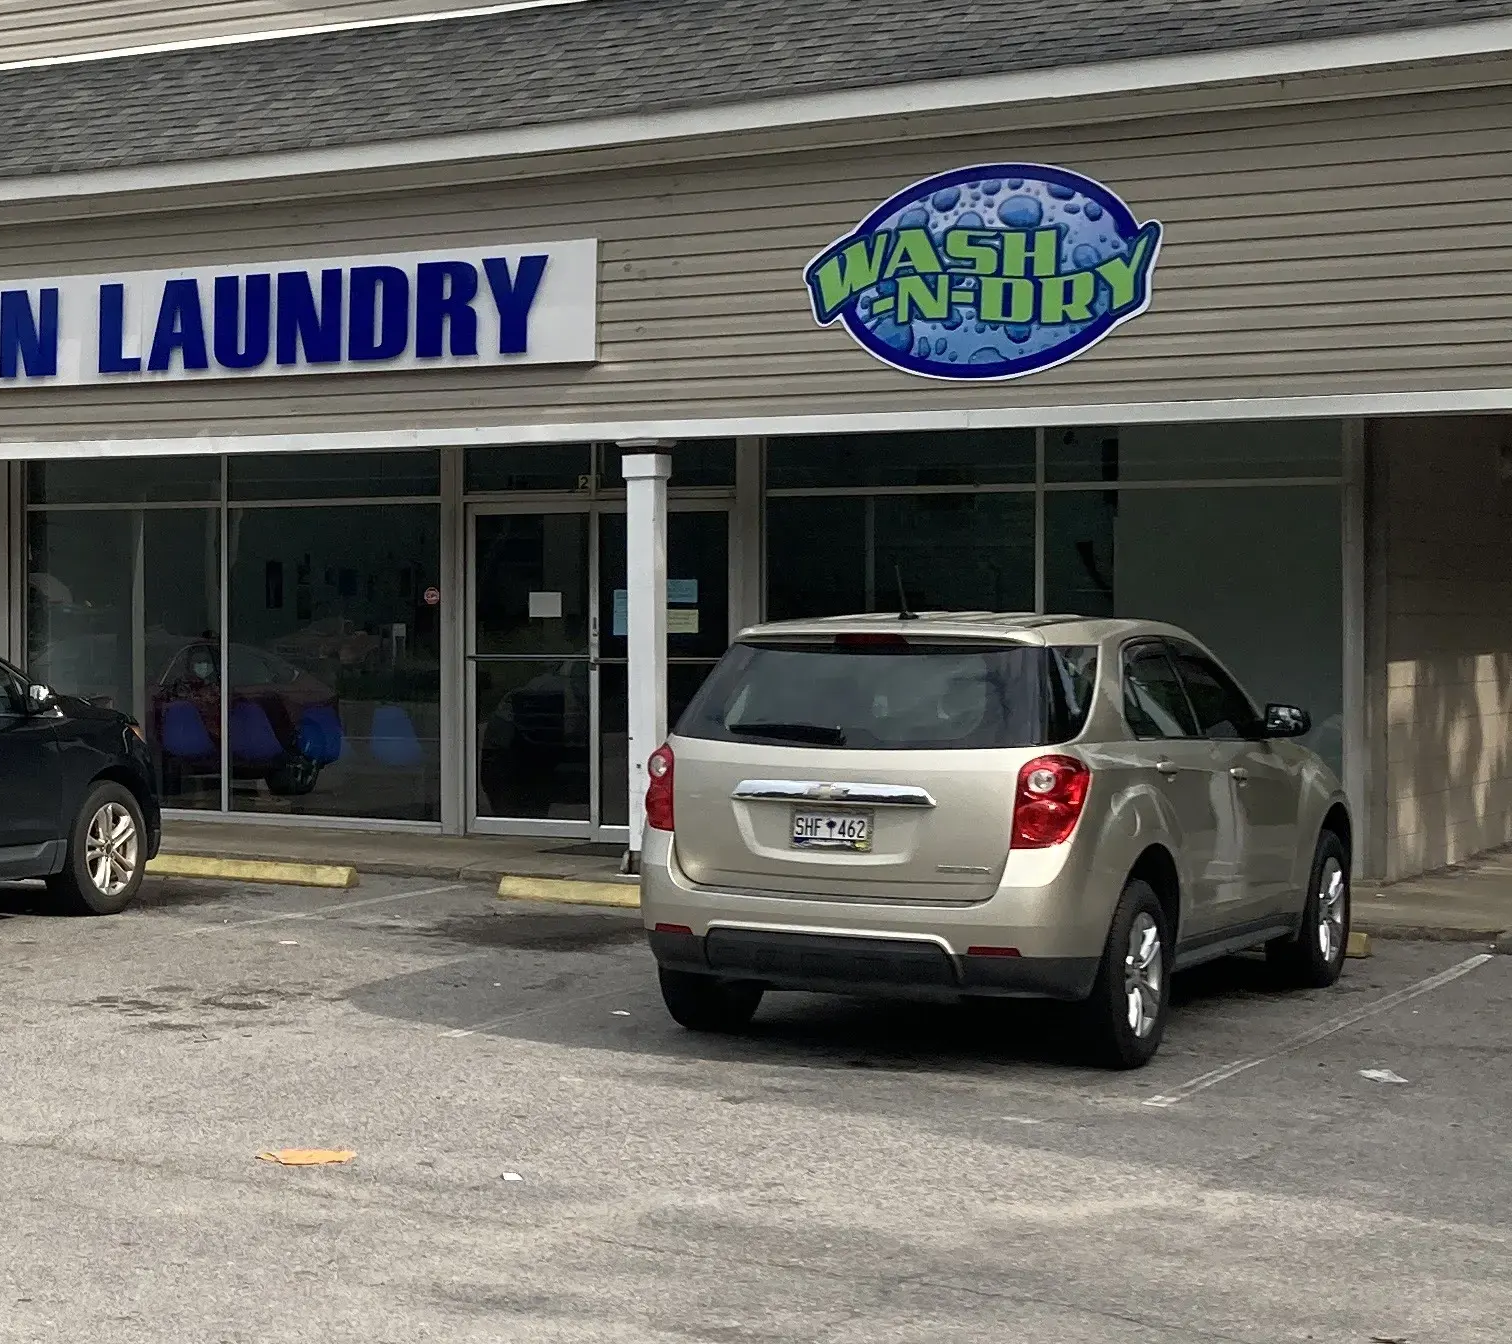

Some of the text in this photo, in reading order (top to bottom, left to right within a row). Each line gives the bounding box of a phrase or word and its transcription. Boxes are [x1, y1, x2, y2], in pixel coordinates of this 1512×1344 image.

[816, 228, 1058, 313] WASH
[98, 255, 547, 372] LAUNDRY
[795, 817, 866, 839] SHF 462
